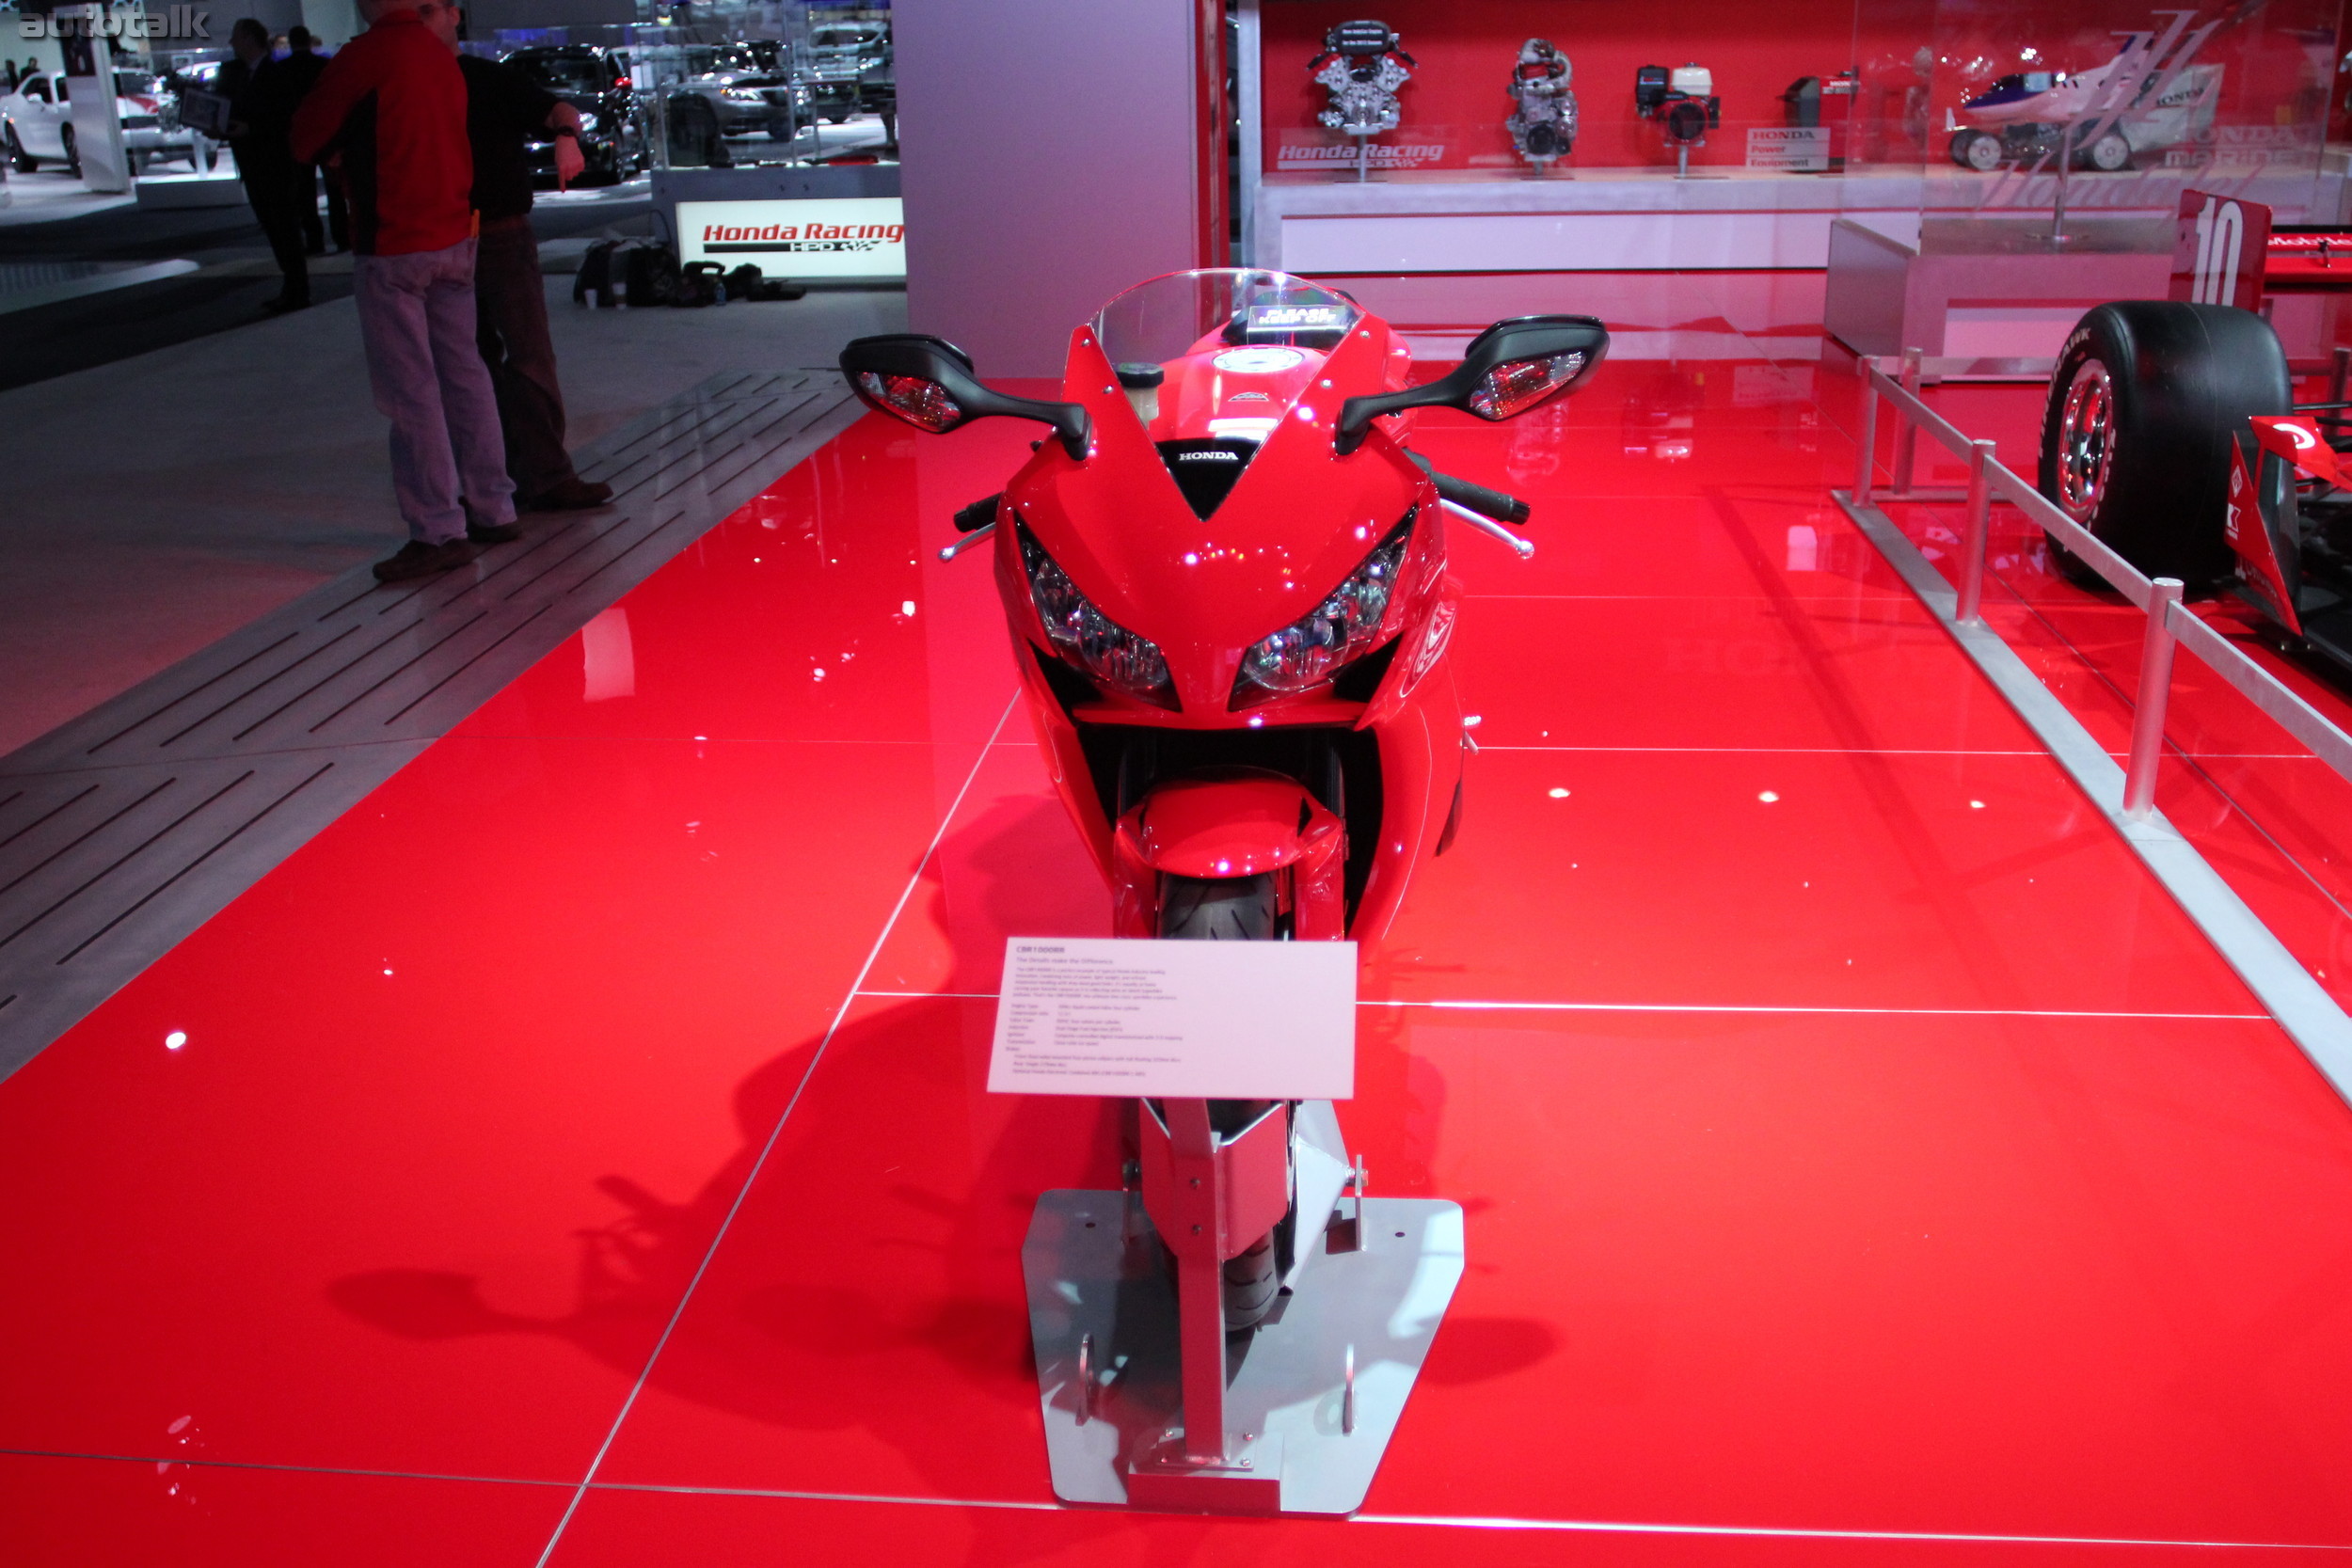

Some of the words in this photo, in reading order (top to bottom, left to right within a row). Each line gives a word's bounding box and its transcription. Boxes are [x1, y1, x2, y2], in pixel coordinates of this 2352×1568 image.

[1753, 131, 1815, 139] HONDA
[1278, 144, 1358, 159] Honda
[1363, 144, 1445, 161] Racing
[1751, 145, 1786, 153] Power
[1750, 158, 1809, 167] Equipment
[703, 224, 799, 241] Honda
[804, 223, 904, 244] Racing
[790, 242, 834, 251] HPD
[2191, 197, 2244, 308] 10
[1259, 313, 1302, 324] KEEP
[1305, 313, 1337, 323] OFF
[1178, 451, 1239, 461] HONDA
